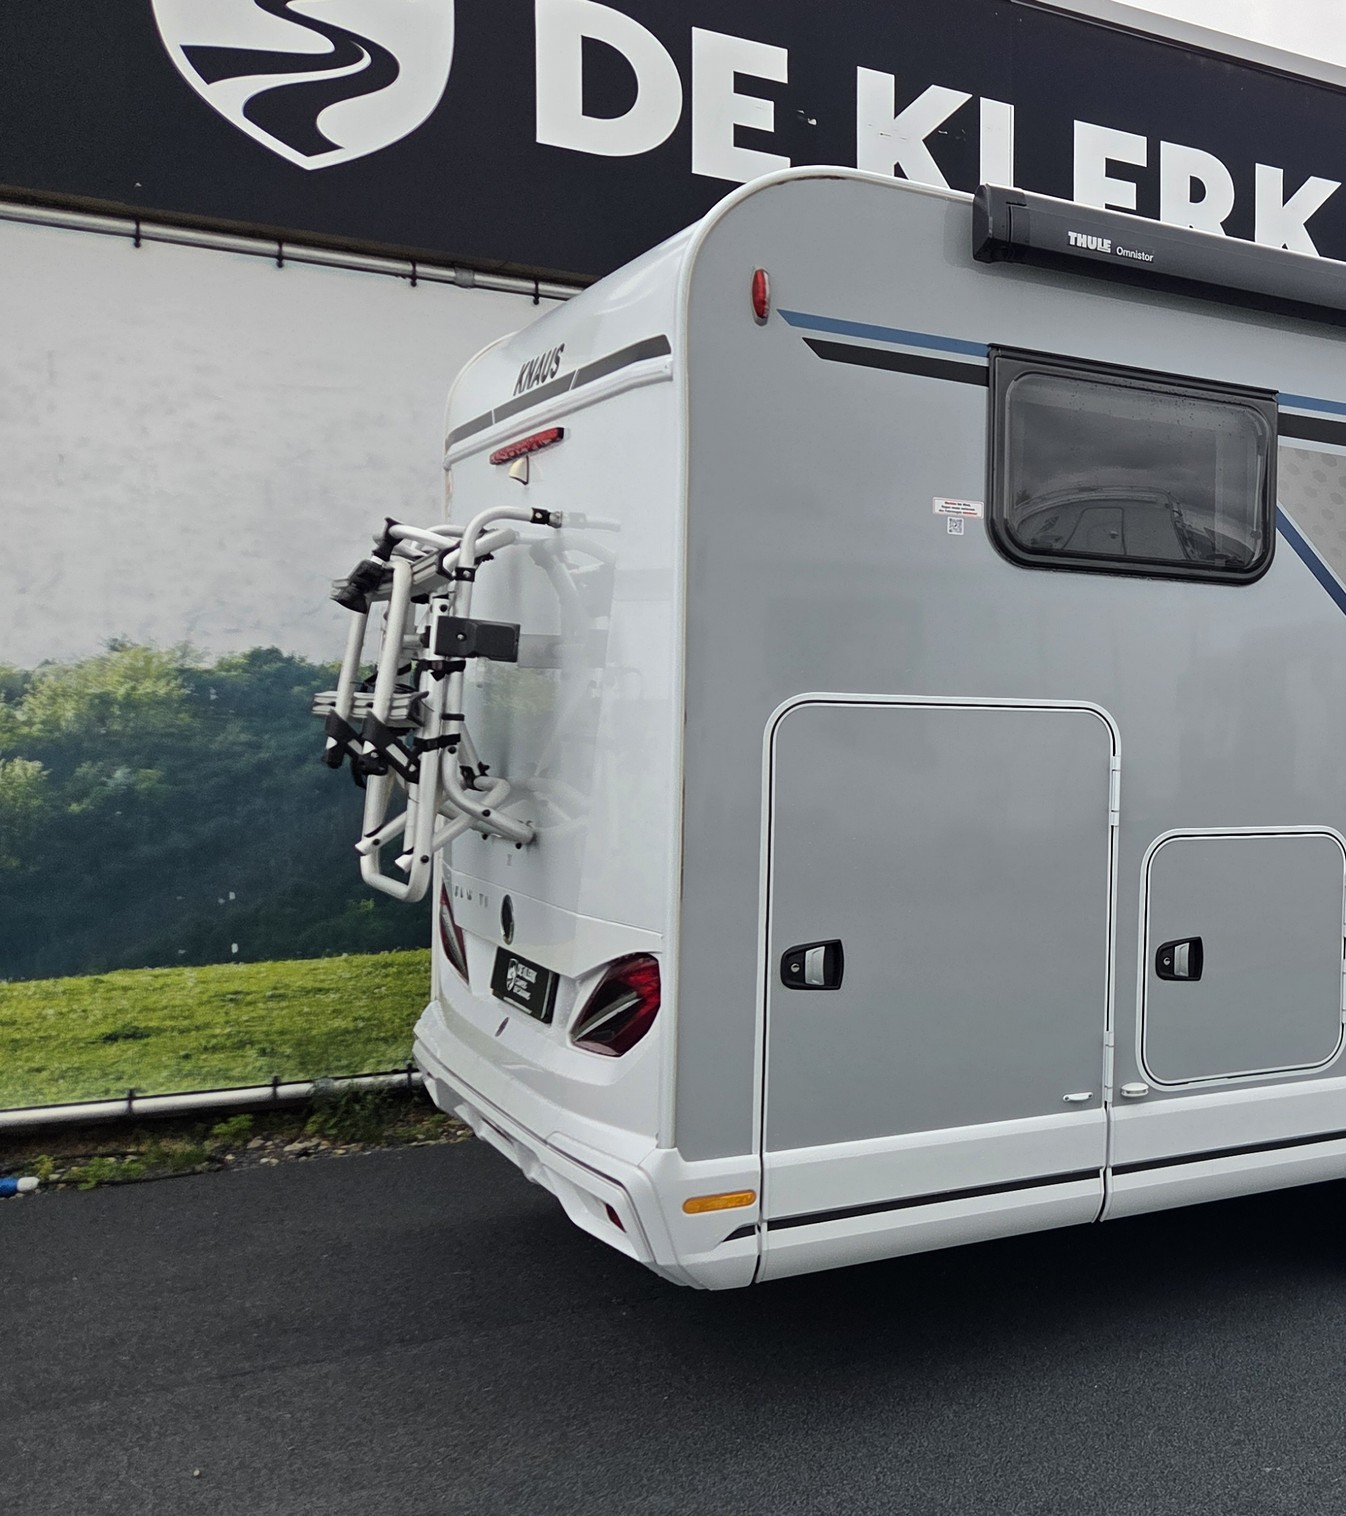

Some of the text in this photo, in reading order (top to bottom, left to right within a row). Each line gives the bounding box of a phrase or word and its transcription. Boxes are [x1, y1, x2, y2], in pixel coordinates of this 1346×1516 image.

[535, 0, 791, 184] DE
[1068, 231, 1154, 262] THULE Omnistor
[513, 343, 565, 396] KNAUS
